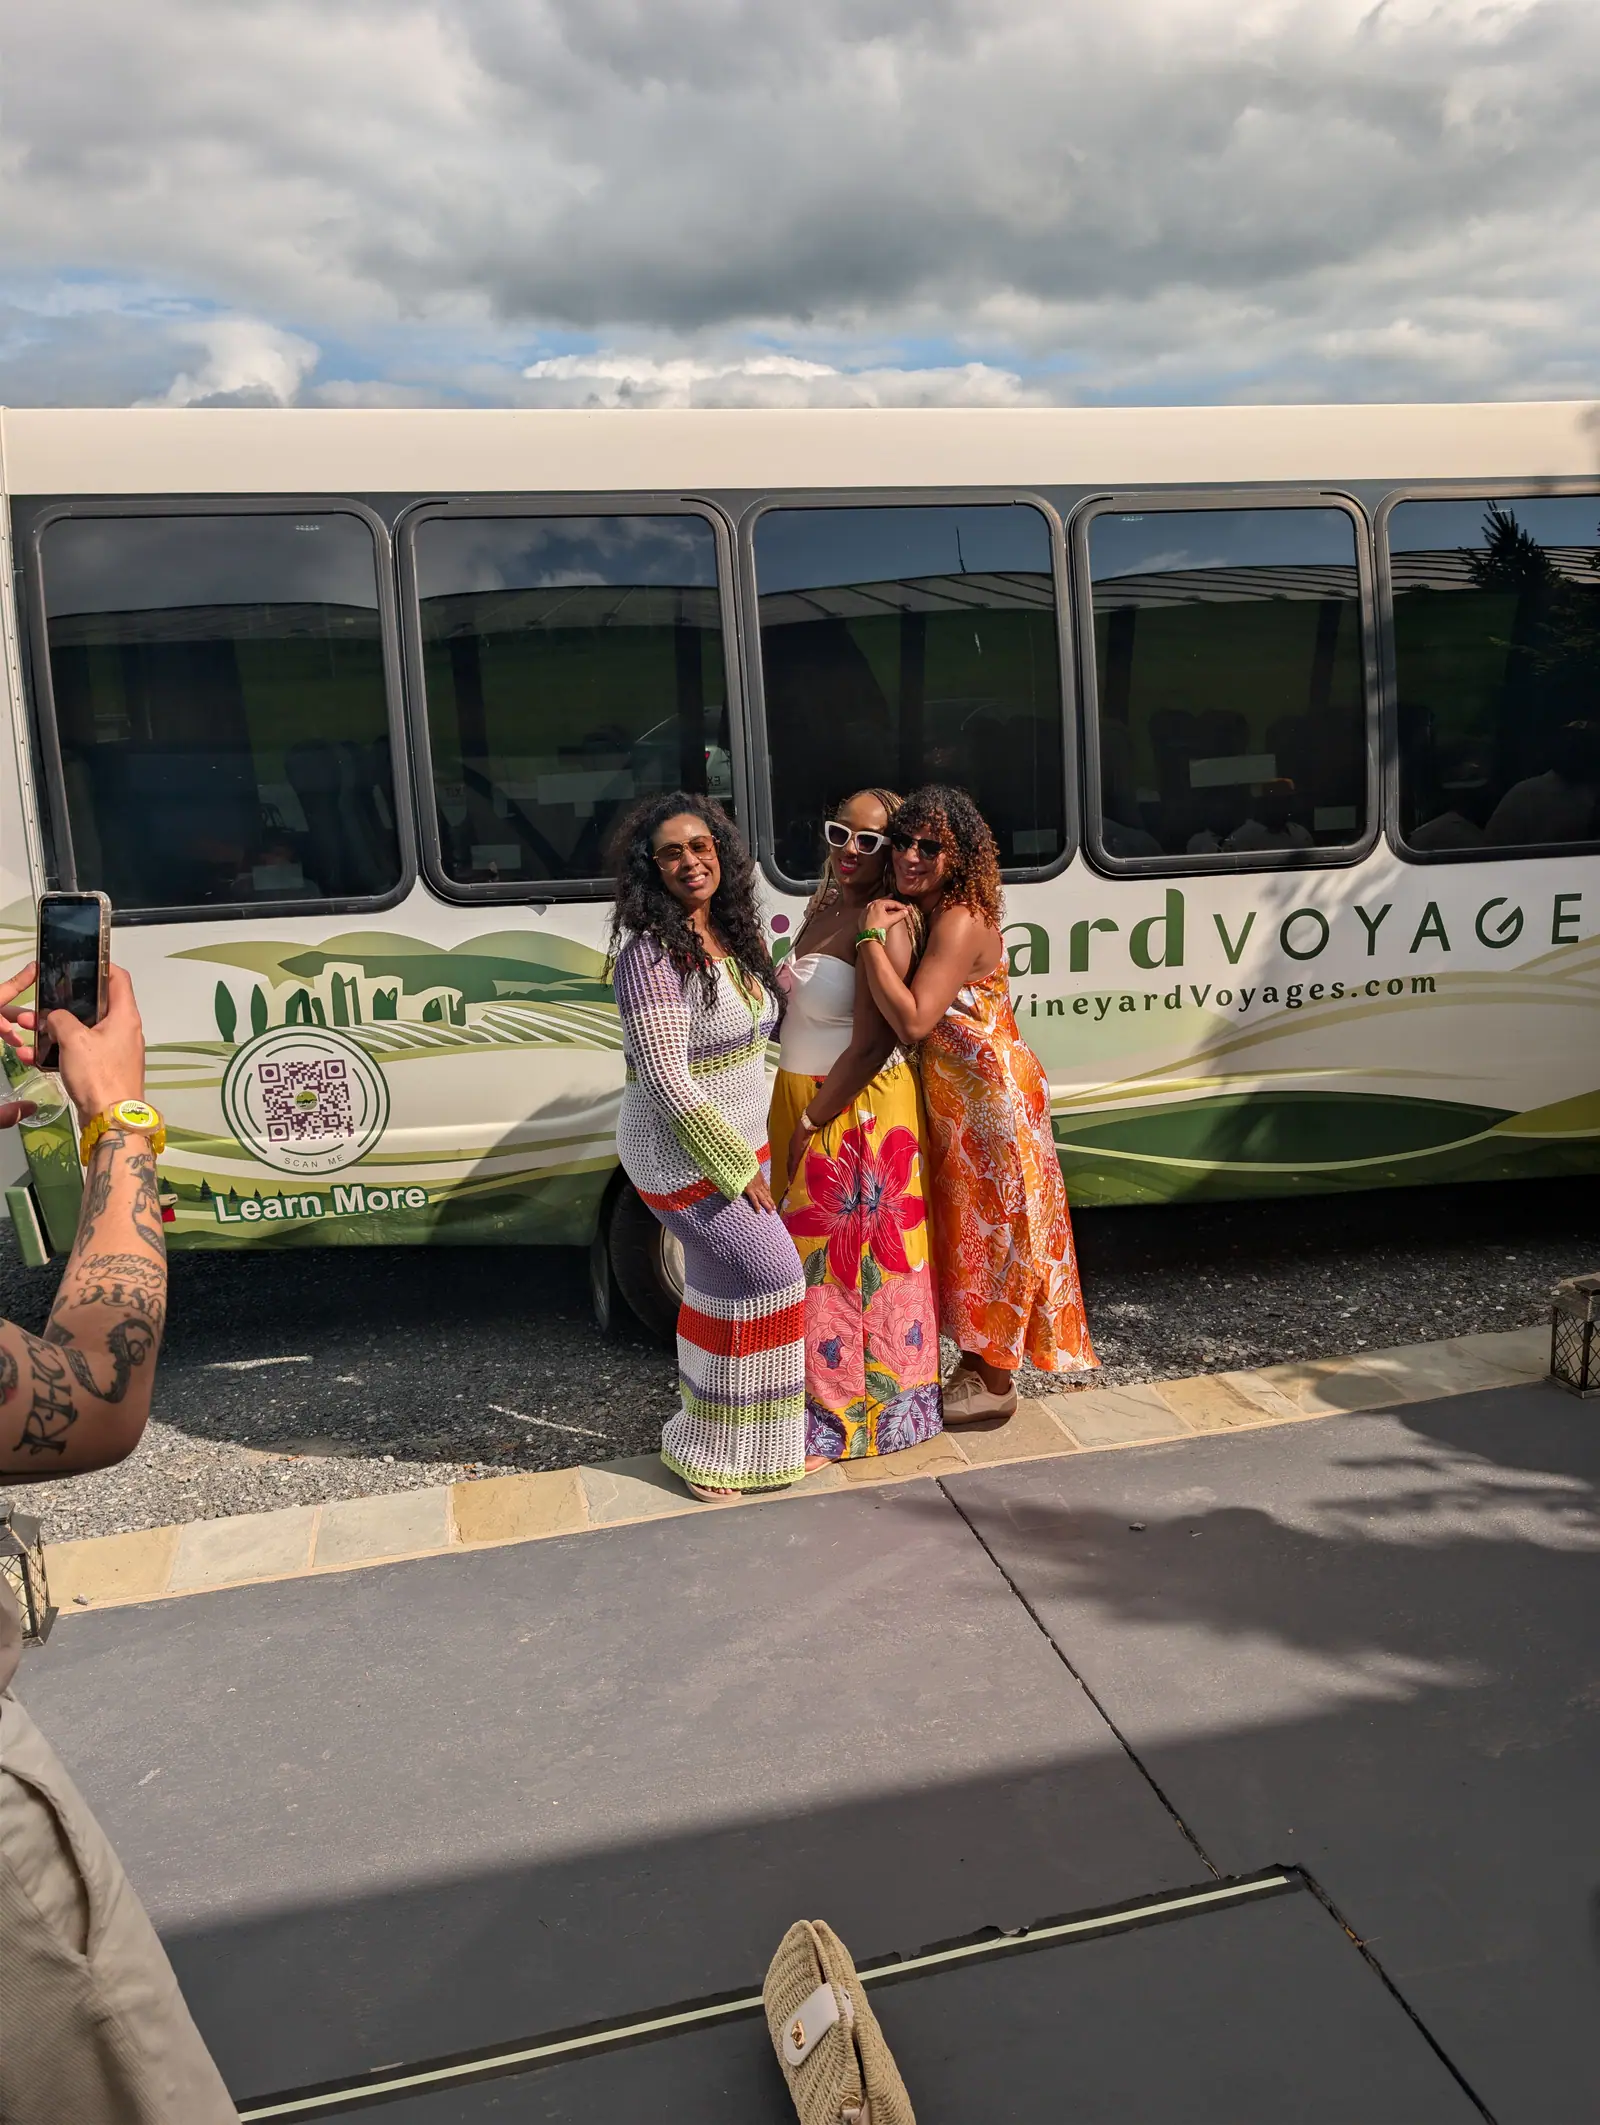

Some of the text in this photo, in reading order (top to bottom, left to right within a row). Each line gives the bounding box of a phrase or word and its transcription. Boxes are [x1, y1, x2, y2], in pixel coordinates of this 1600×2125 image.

[1213, 893, 1582, 965] VOYAGE
[284, 1154, 345, 1168] SCAN ME
[215, 1184, 427, 1222] Learn More
